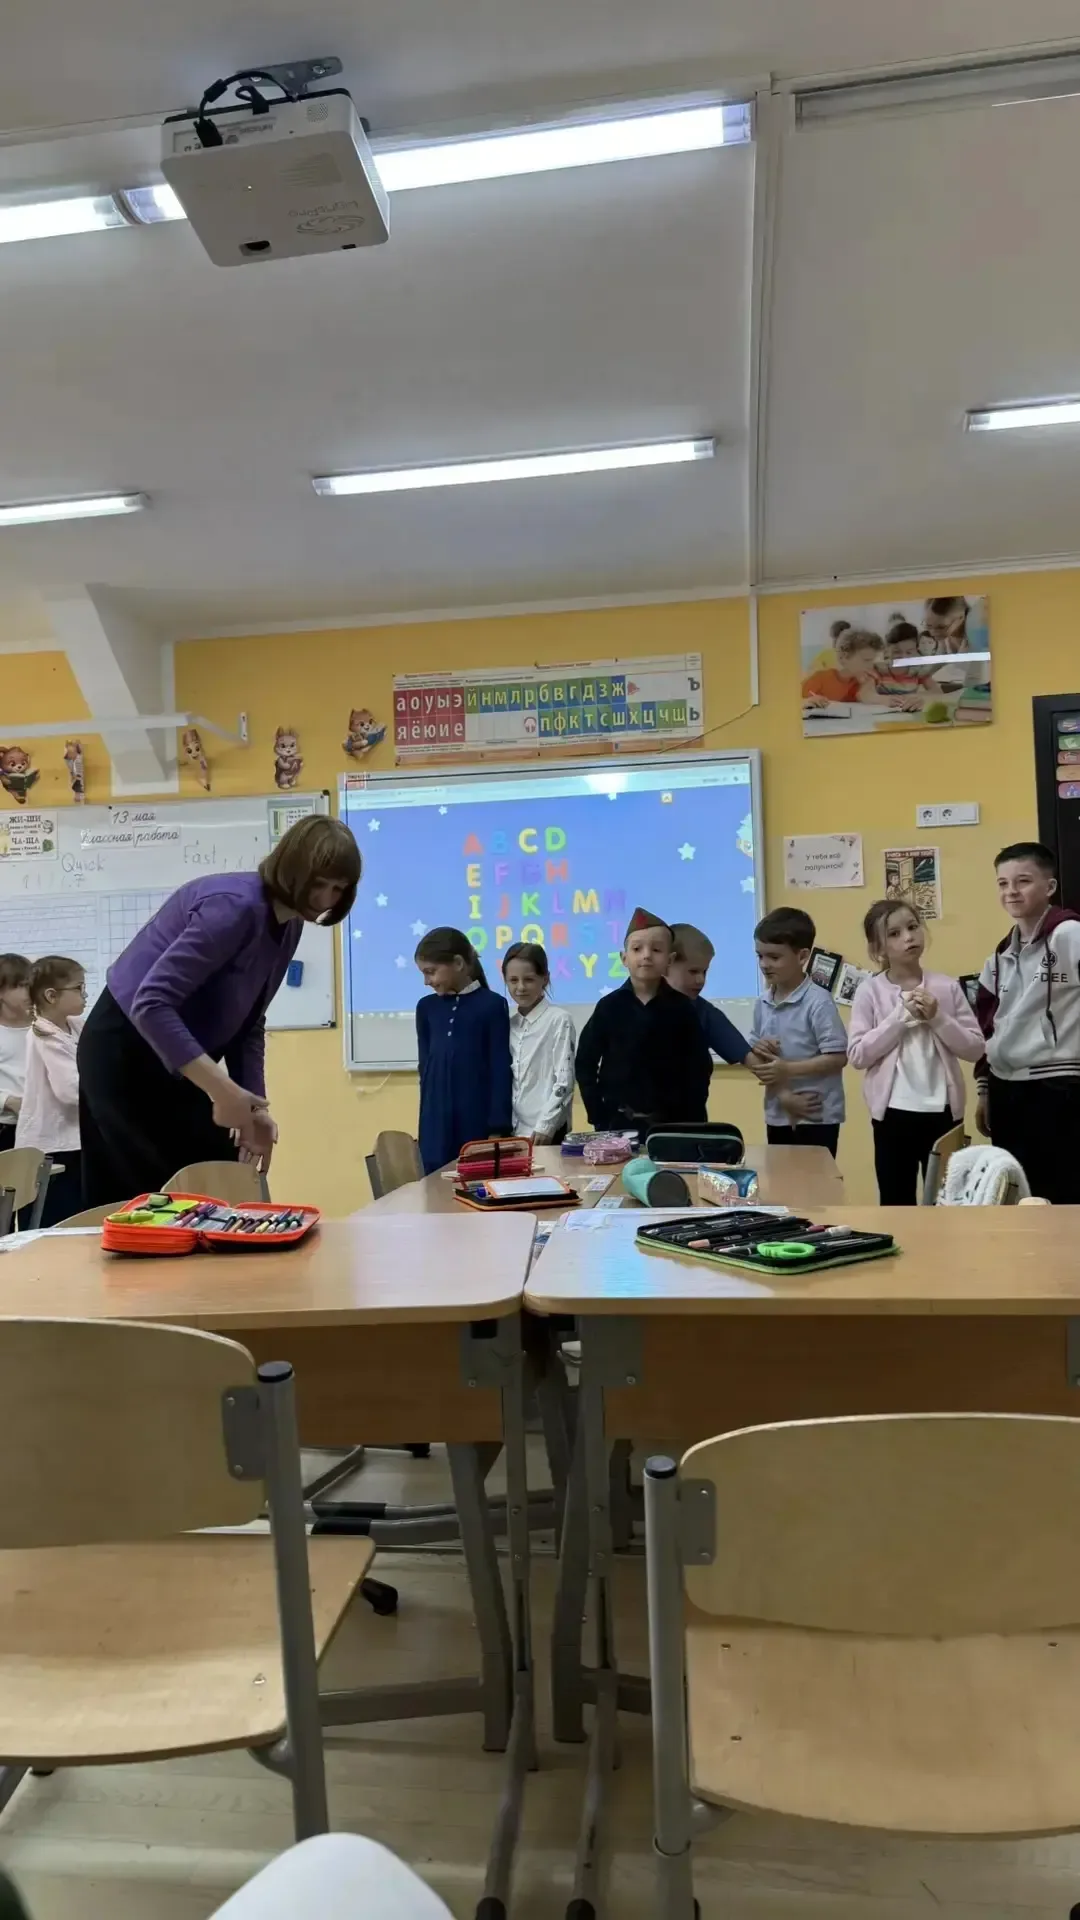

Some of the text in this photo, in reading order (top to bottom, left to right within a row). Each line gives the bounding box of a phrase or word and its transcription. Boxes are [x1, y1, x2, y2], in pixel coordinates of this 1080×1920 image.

[396, 677, 700, 714] а о у ы э й н м л р б в г д з ж ъ
[397, 707, 700, 740] я ё ю и е п ф к т с ш х ц ч щ ь
[112, 810, 157, 825] 13 мая
[133, 826, 180, 848] работа
[463, 832, 485, 857] A
[518, 827, 539, 854] C
[544, 826, 567, 853] D
[61, 852, 106, 874] Quick
[466, 862, 482, 889] E
[494, 861, 510, 886] F
[545, 857, 569, 885] H
[468, 894, 483, 920] I
[498, 893, 510, 920] J
[521, 891, 541, 917] K
[552, 890, 565, 914] L
[572, 888, 600, 915] M
[466, 925, 488, 952] O
[495, 924, 513, 950] P
[520, 923, 545, 950] Q
[551, 922, 570, 948] R
[606, 920, 625, 945] T
[552, 951, 629, 979] X Y Z
